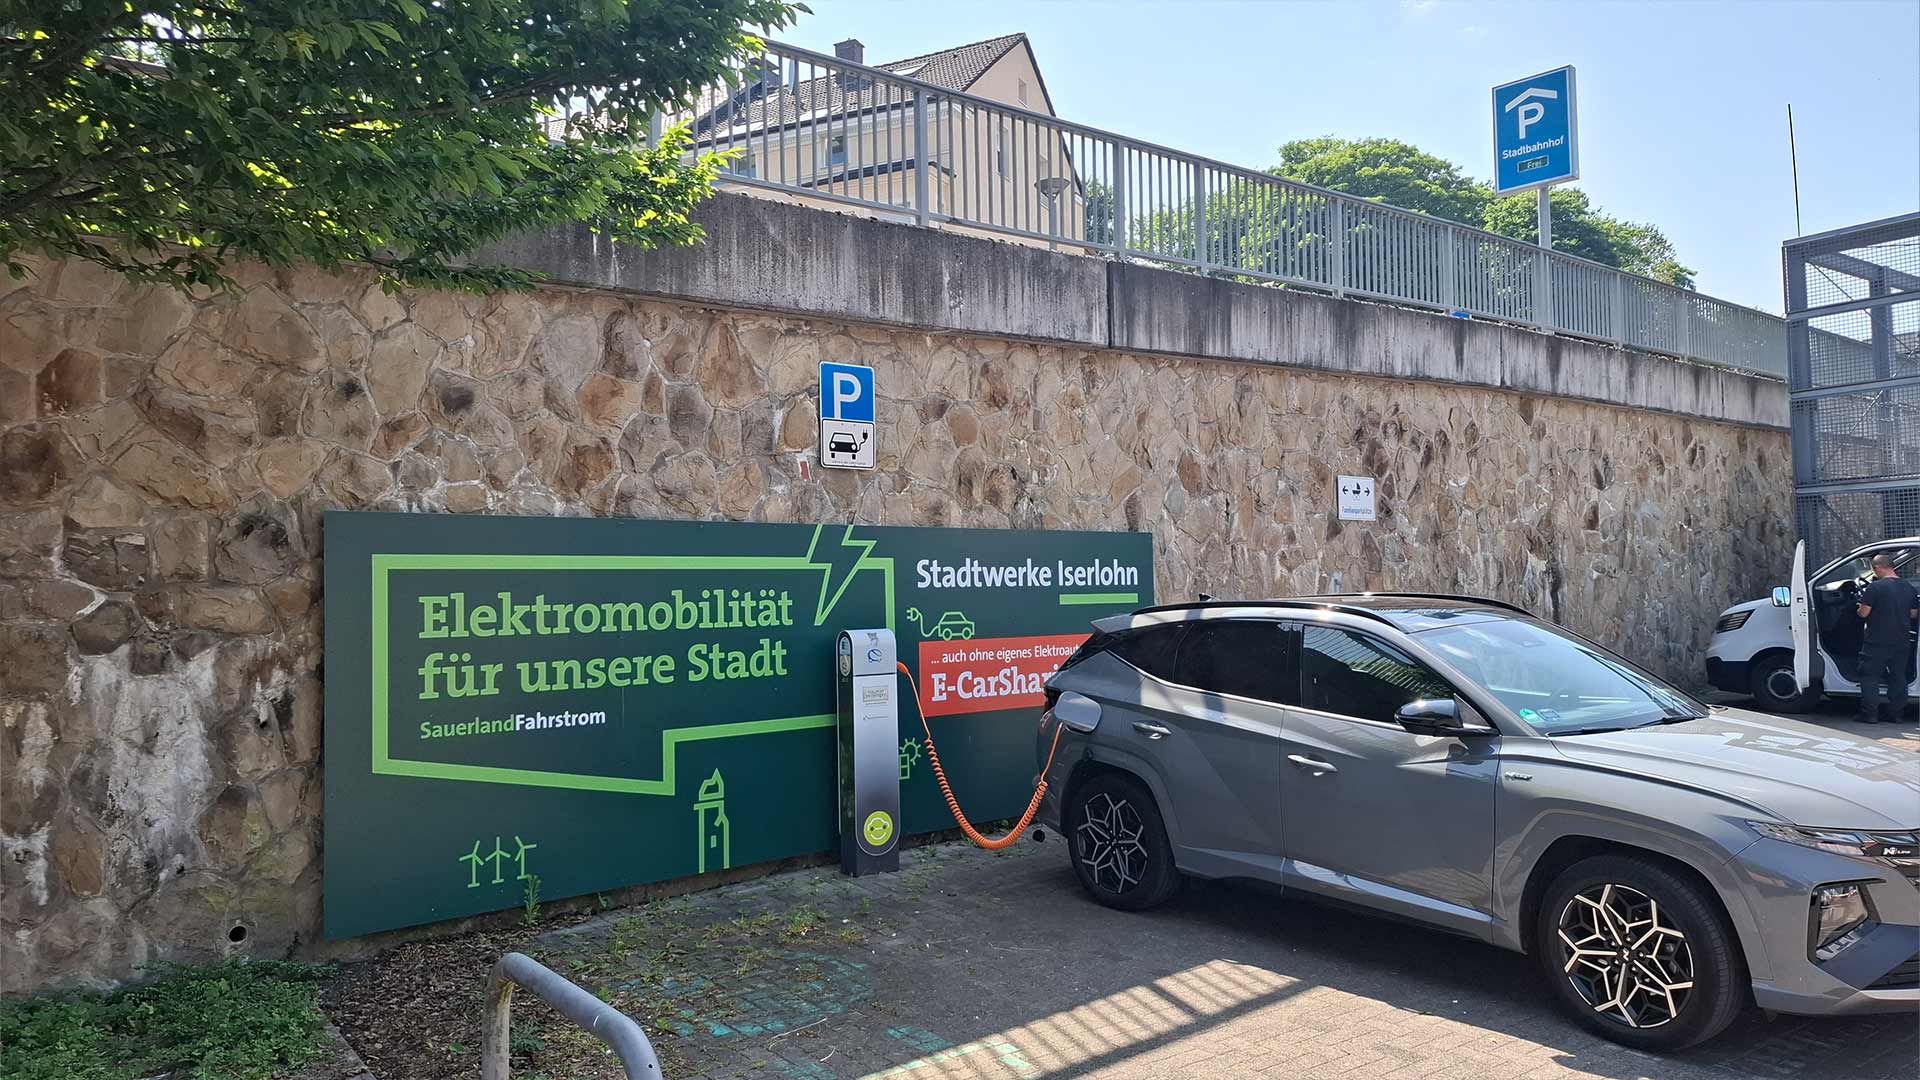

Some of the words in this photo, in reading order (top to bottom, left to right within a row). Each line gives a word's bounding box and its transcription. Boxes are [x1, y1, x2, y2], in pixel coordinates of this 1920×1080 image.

[1518, 102, 1544, 139] P
[1502, 135, 1564, 159] Stadtbahnhof
[833, 372, 862, 419] P
[916, 558, 1052, 588] Stadtwerke
[1058, 558, 1138, 587] Iserlohn
[418, 589, 793, 639] Elektromobilität
[418, 652, 503, 699] für
[516, 654, 676, 693] unsere
[687, 638, 787, 682] Stadt
[942, 649, 967, 663] auch
[969, 648, 994, 662] ohne
[996, 647, 1032, 662] eigenes
[1034, 644, 1081, 657] Elektroaut
[420, 711, 606, 739] SauerlandFahrstrom
